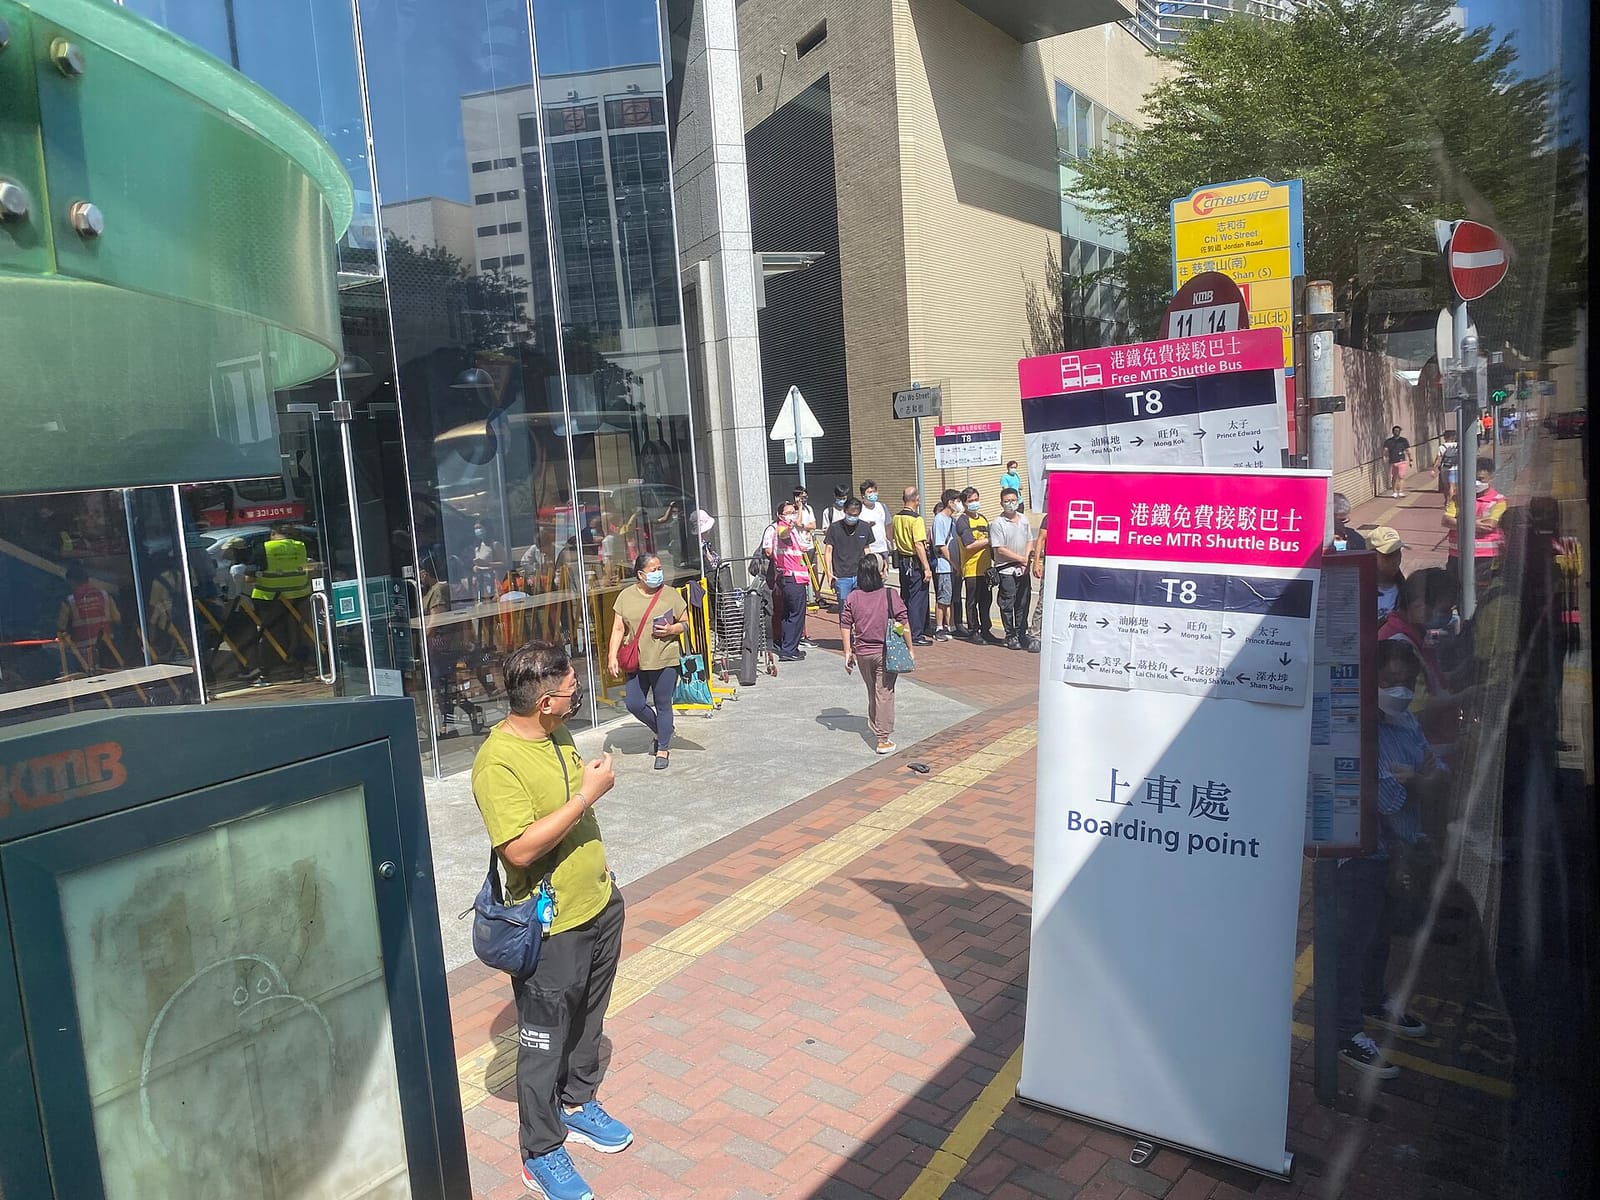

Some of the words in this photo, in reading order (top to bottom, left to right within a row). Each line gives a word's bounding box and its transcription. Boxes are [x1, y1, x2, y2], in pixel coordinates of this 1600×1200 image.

[1203, 194, 1246, 208] CITYBUS
[1216, 218, 1246, 232] 志和街
[1204, 236, 1218, 244] Chi
[1220, 234, 1233, 242] Wo
[1234, 230, 1258, 240] Street
[1200, 244, 1222, 254] 佐敦道
[1223, 242, 1244, 251] Jordan
[1246, 240, 1264, 248] Road
[1180, 266, 1188, 276] 往
[1232, 272, 1254, 280] Shan
[1258, 267, 1272, 278] (S)
[1192, 290, 1214, 305] KMB
[1177, 314, 1193, 338] 11
[1208, 310, 1226, 334] 14
[1110, 336, 1241, 370] 港鐵免費接駁巴士
[1111, 372, 1137, 384] Free
[1140, 368, 1168, 382] MTR
[1170, 362, 1216, 378] Shuttle
[1220, 360, 1242, 372] Bus
[1125, 389, 1164, 416] T8
[1158, 428, 1180, 440] 旺角
[1228, 418, 1249, 430] 太子
[1216, 431, 1236, 440] Prince
[1237, 428, 1262, 438] Edward
[961, 434, 972, 442] T8
[1153, 440, 1172, 448] Mong
[1172, 438, 1185, 446] Kok
[1130, 502, 1302, 533] 港鐵免費接駁巴士
[1128, 531, 1162, 546] Free
[1166, 533, 1202, 548] MTR
[1206, 534, 1265, 550] Shuttle
[1268, 538, 1300, 552] Bus
[1161, 578, 1198, 604] T8
[1068, 622, 1088, 630] Jordan
[1069, 611, 1088, 622] 佐敦
[1186, 621, 1208, 632] 旺角
[1258, 626, 1280, 637] 太子
[1118, 626, 1128, 634] Yau
[1180, 632, 1199, 640] Mong
[1246, 637, 1265, 645] Prince
[1266, 639, 1291, 647] Edward
[1072, 664, 1086, 672] King
[1100, 666, 1111, 674] Mei
[1102, 656, 1121, 667] 美孚
[1137, 659, 1168, 672] 荔枝角
[1256, 671, 1288, 683] 深水埗
[1136, 670, 1144, 678] Lai
[1183, 675, 1208, 685] Cheung
[1220, 678, 1235, 686] Wan
[1250, 682, 1268, 690] Sham
[0, 741, 127, 817] KMB
[1096, 768, 1232, 822] 上車處
[1067, 810, 1180, 852] Boarding
[1187, 832, 1260, 858] point
